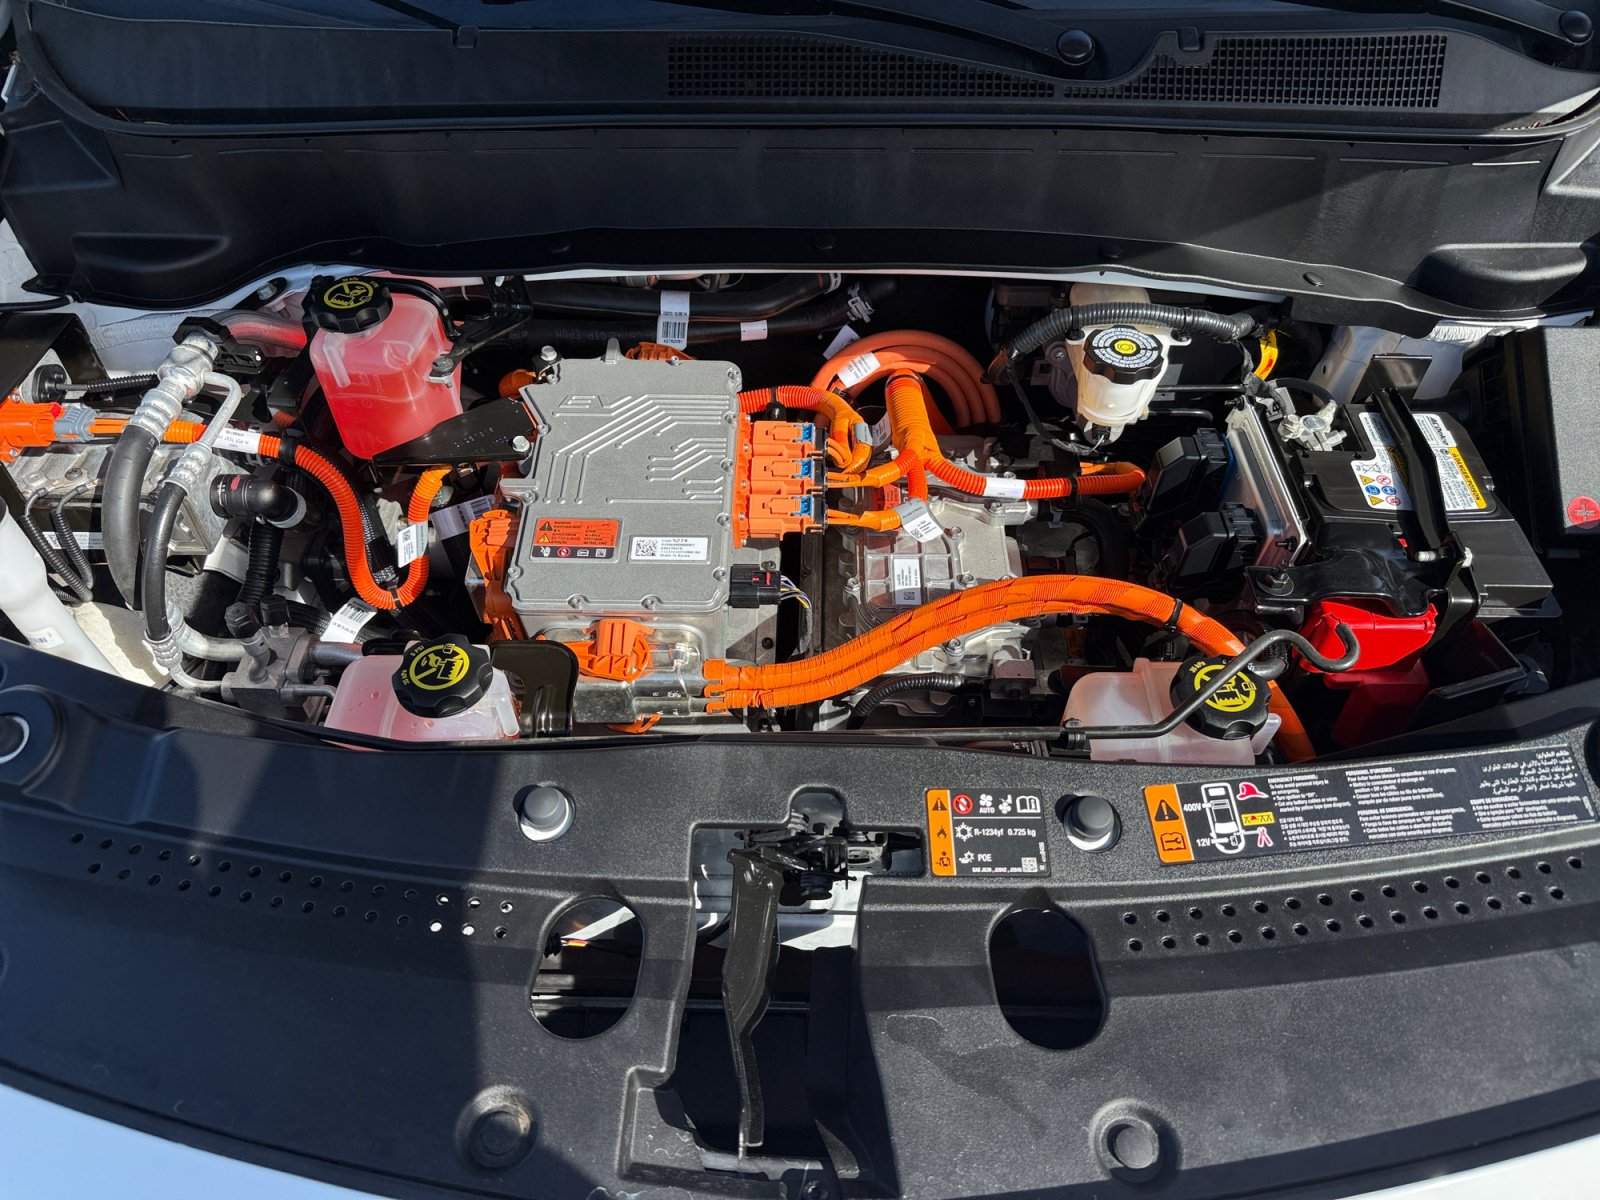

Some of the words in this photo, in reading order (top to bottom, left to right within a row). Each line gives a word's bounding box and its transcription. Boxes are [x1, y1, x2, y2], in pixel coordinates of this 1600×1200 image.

[1430, 417, 1448, 446] ACDelco
[415, 645, 425, 654] PSI
[1183, 803, 1202, 812] 400V
[974, 828, 1004, 837] R-1234yf
[1027, 828, 1036, 837] kg
[1196, 838, 1211, 847] 12V
[978, 854, 992, 862] POE
